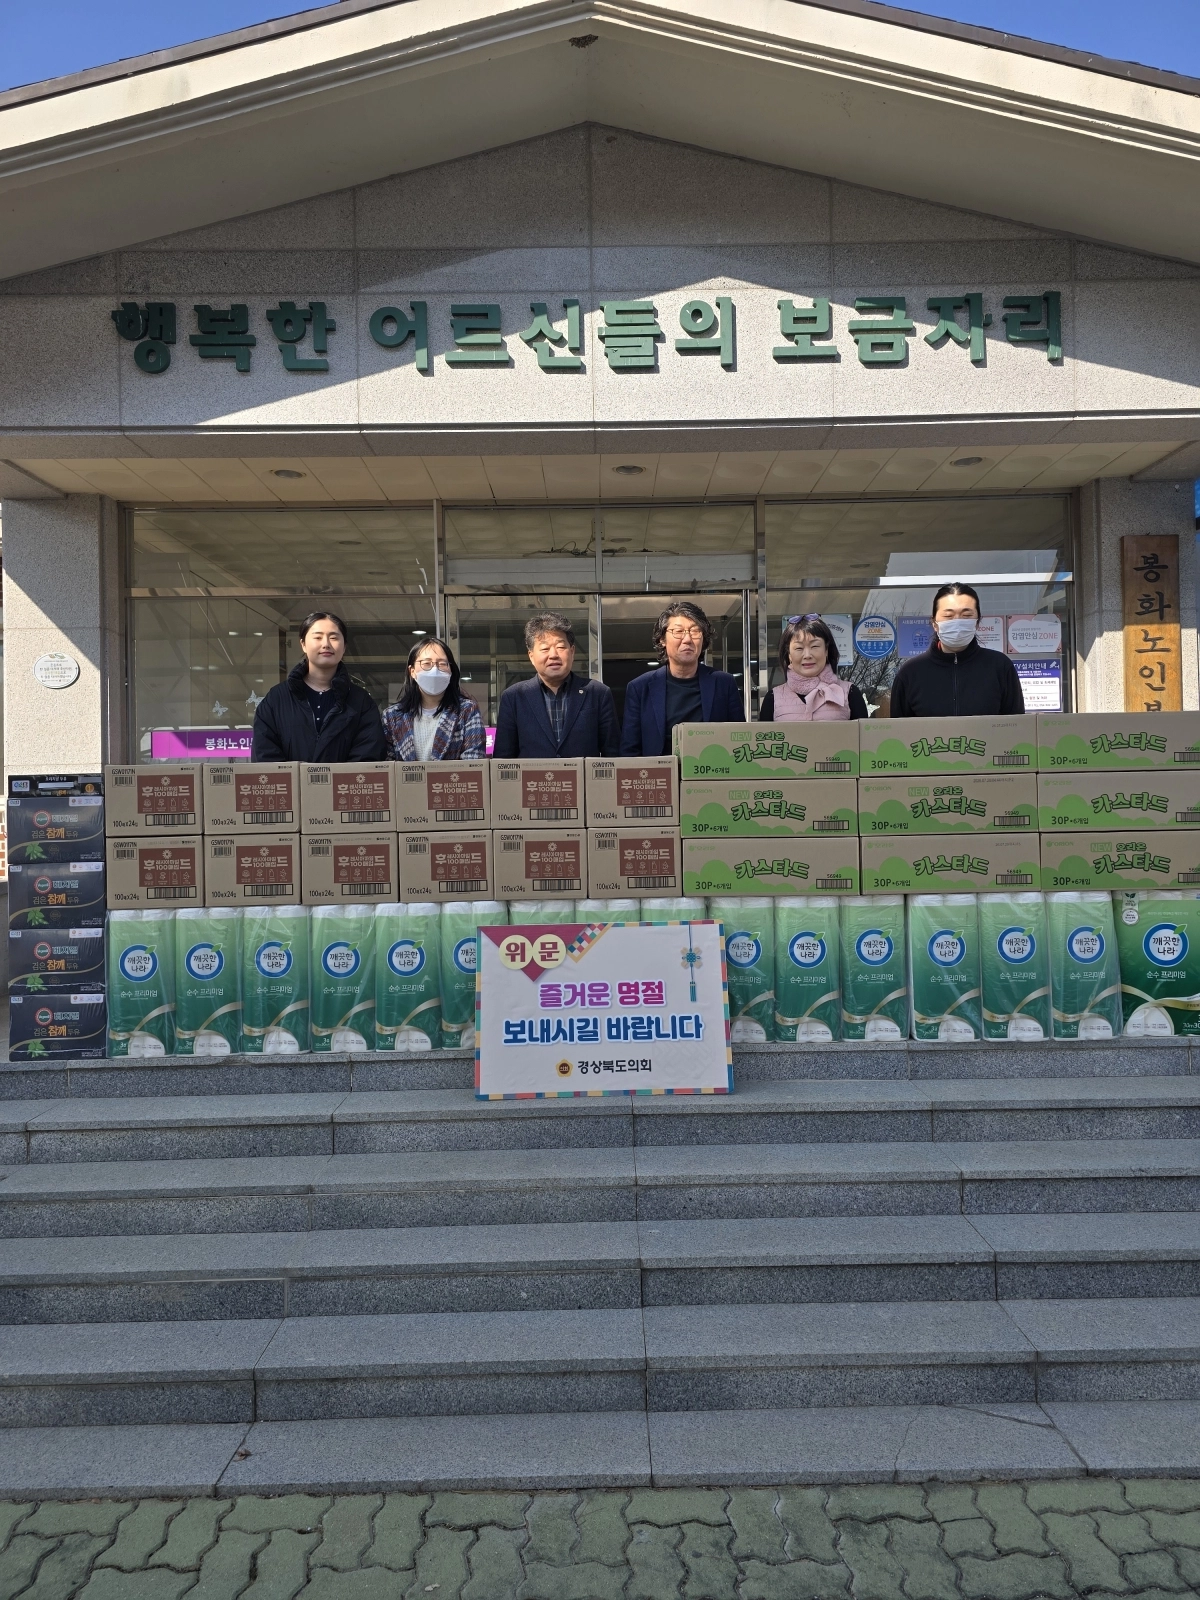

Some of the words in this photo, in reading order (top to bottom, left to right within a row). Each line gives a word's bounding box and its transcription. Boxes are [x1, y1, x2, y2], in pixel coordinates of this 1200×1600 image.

[111, 301, 336, 373] 행복한
[368, 297, 735, 372] 어르신들의
[772, 291, 1063, 364] 보금자리
[1012, 632, 1038, 640] 감염안심
[732, 733, 751, 741] NEW
[755, 732, 785, 740] 오리온
[205, 738, 252, 751] 봉화노인
[911, 736, 986, 757] 카스타드
[1090, 732, 1167, 753] 카스타드
[733, 742, 808, 762] 카스타드
[729, 791, 749, 799] NEW
[754, 790, 783, 799] 오리온
[933, 786, 963, 796] 오리온
[911, 796, 987, 818] 카스타드
[1091, 792, 1169, 813] 카스타드
[731, 800, 806, 821] 카스타드
[46, 828, 64, 839] 참깨
[1091, 843, 1111, 852] NEW
[1116, 842, 1146, 852] 오리온
[913, 854, 989, 875] 카스타드
[1093, 852, 1170, 873] 카스타드
[734, 858, 809, 879] 카스타드
[48, 894, 66, 904] 참깨
[936, 941, 958, 949] 깨끗한
[1005, 938, 1028, 946] 깨끗한
[1075, 938, 1097, 946] 깨끗한
[1152, 936, 1180, 946] 깨끗한
[395, 951, 418, 959] 깨끗한
[461, 948, 476, 956] 깨끗
[1158, 947, 1175, 955] 나라
[127, 956, 150, 965] 깨끗한
[193, 954, 216, 963] 깨끗한
[263, 953, 285, 961] 깨끗한
[330, 952, 353, 961] 깨끗한
[47, 960, 65, 970] 참깨
[1147, 971, 1160, 979] 순수
[1161, 971, 1186, 979] 프리미엄
[539, 982, 610, 1008] 즐거운
[618, 981, 665, 1006] 명절
[48, 1026, 66, 1036] 참깨
[503, 1018, 600, 1044] 보내시길
[606, 1014, 703, 1041] 바랍니다
[578, 1058, 652, 1074] 경상북도의회
